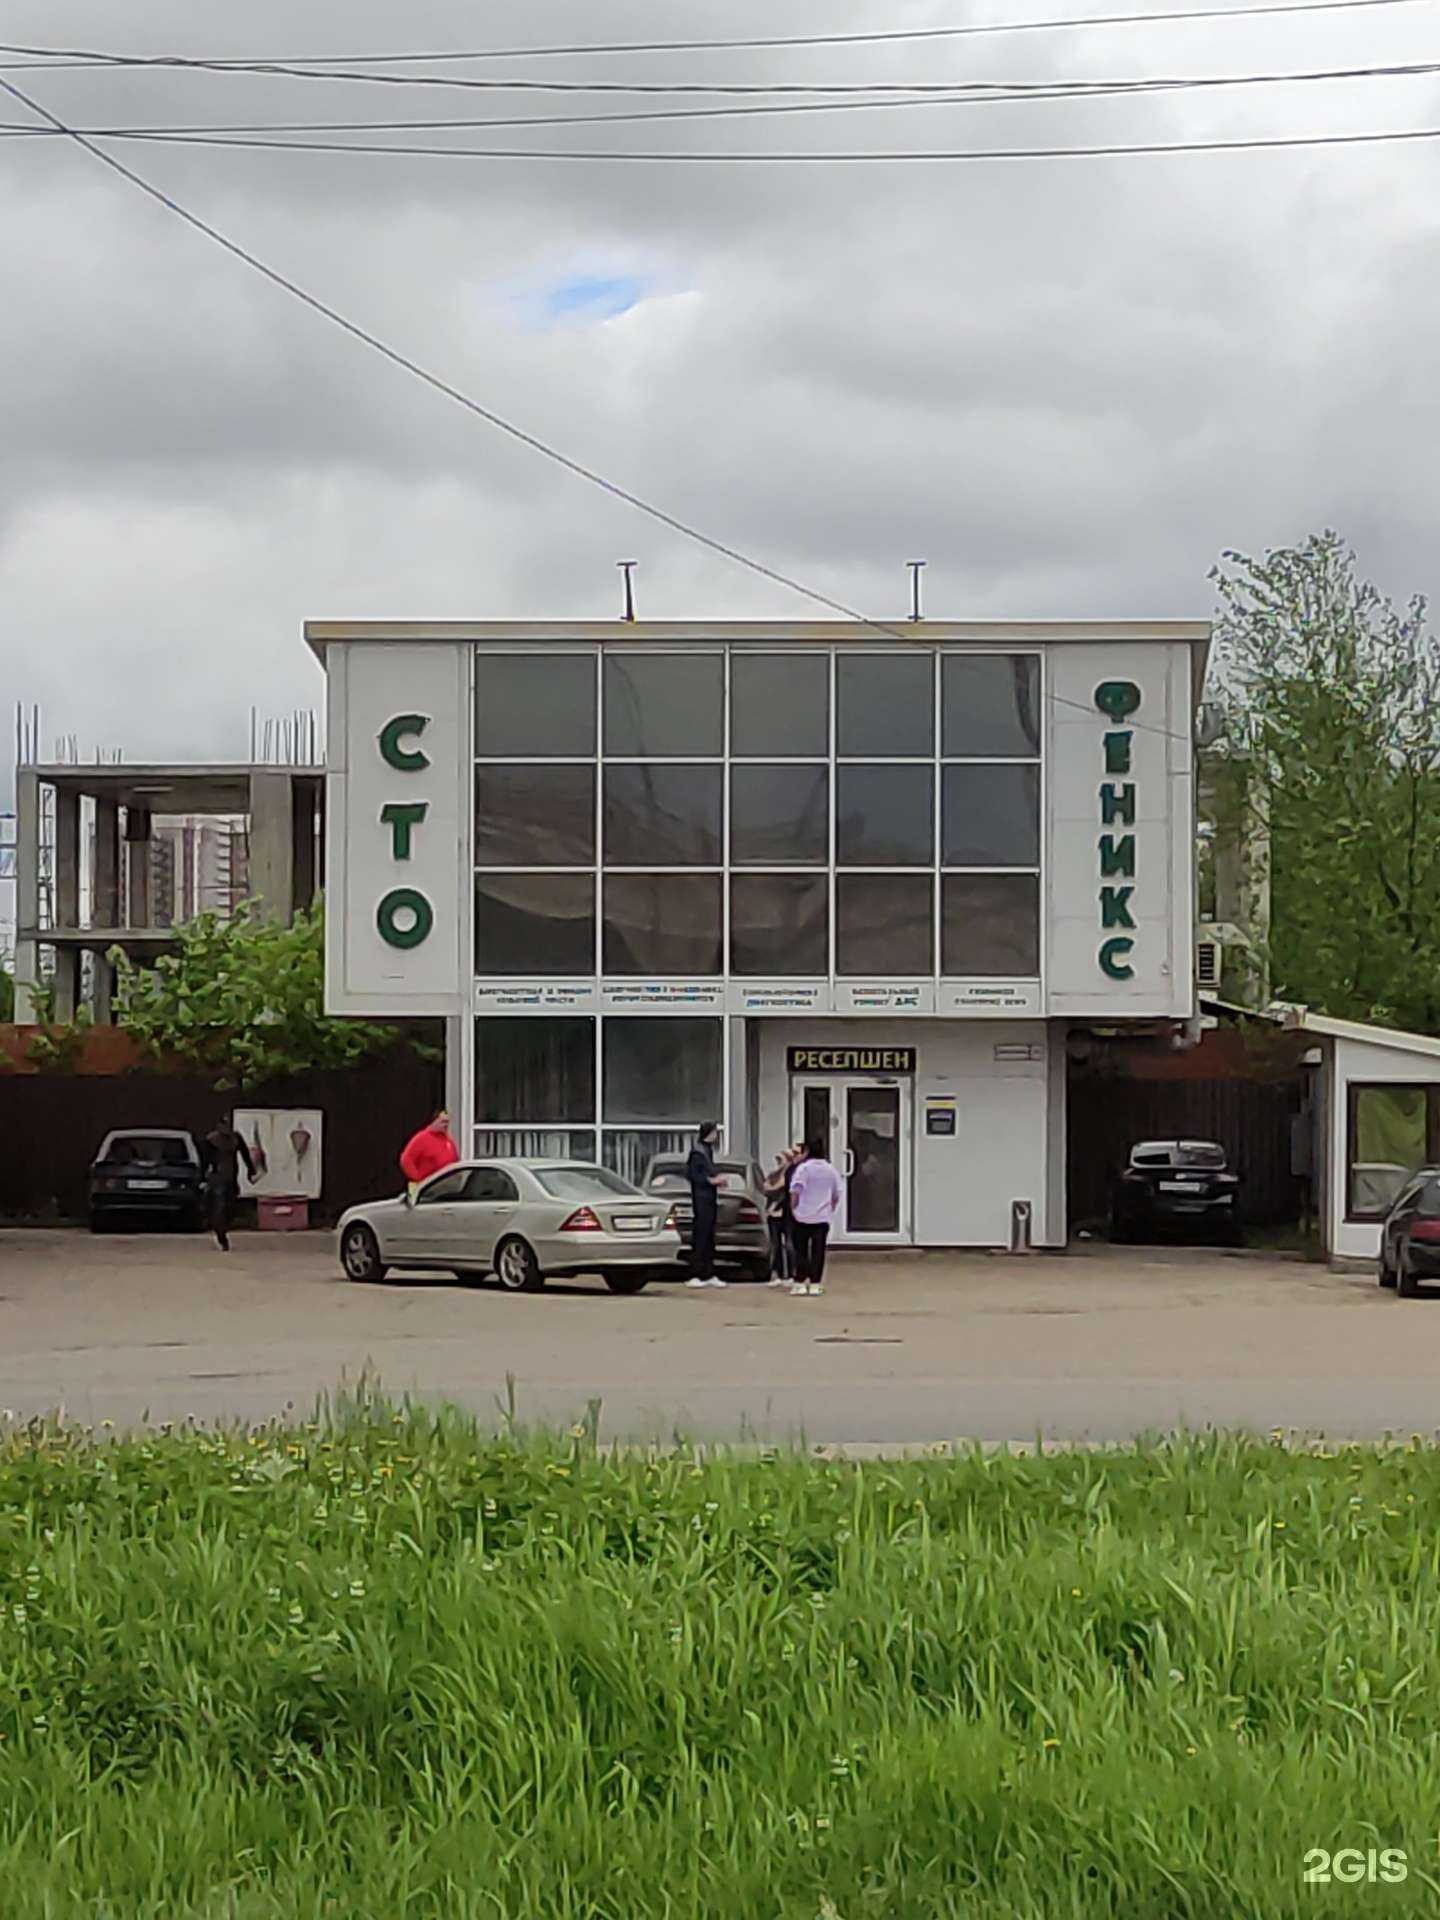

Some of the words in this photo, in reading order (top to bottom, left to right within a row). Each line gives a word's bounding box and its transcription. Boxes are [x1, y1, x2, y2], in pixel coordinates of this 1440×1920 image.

[376, 713, 434, 951] СТО
[1094, 680, 1142, 981] ФЕНИКС
[794, 1050, 910, 1070] РЕСЕПШЕН
